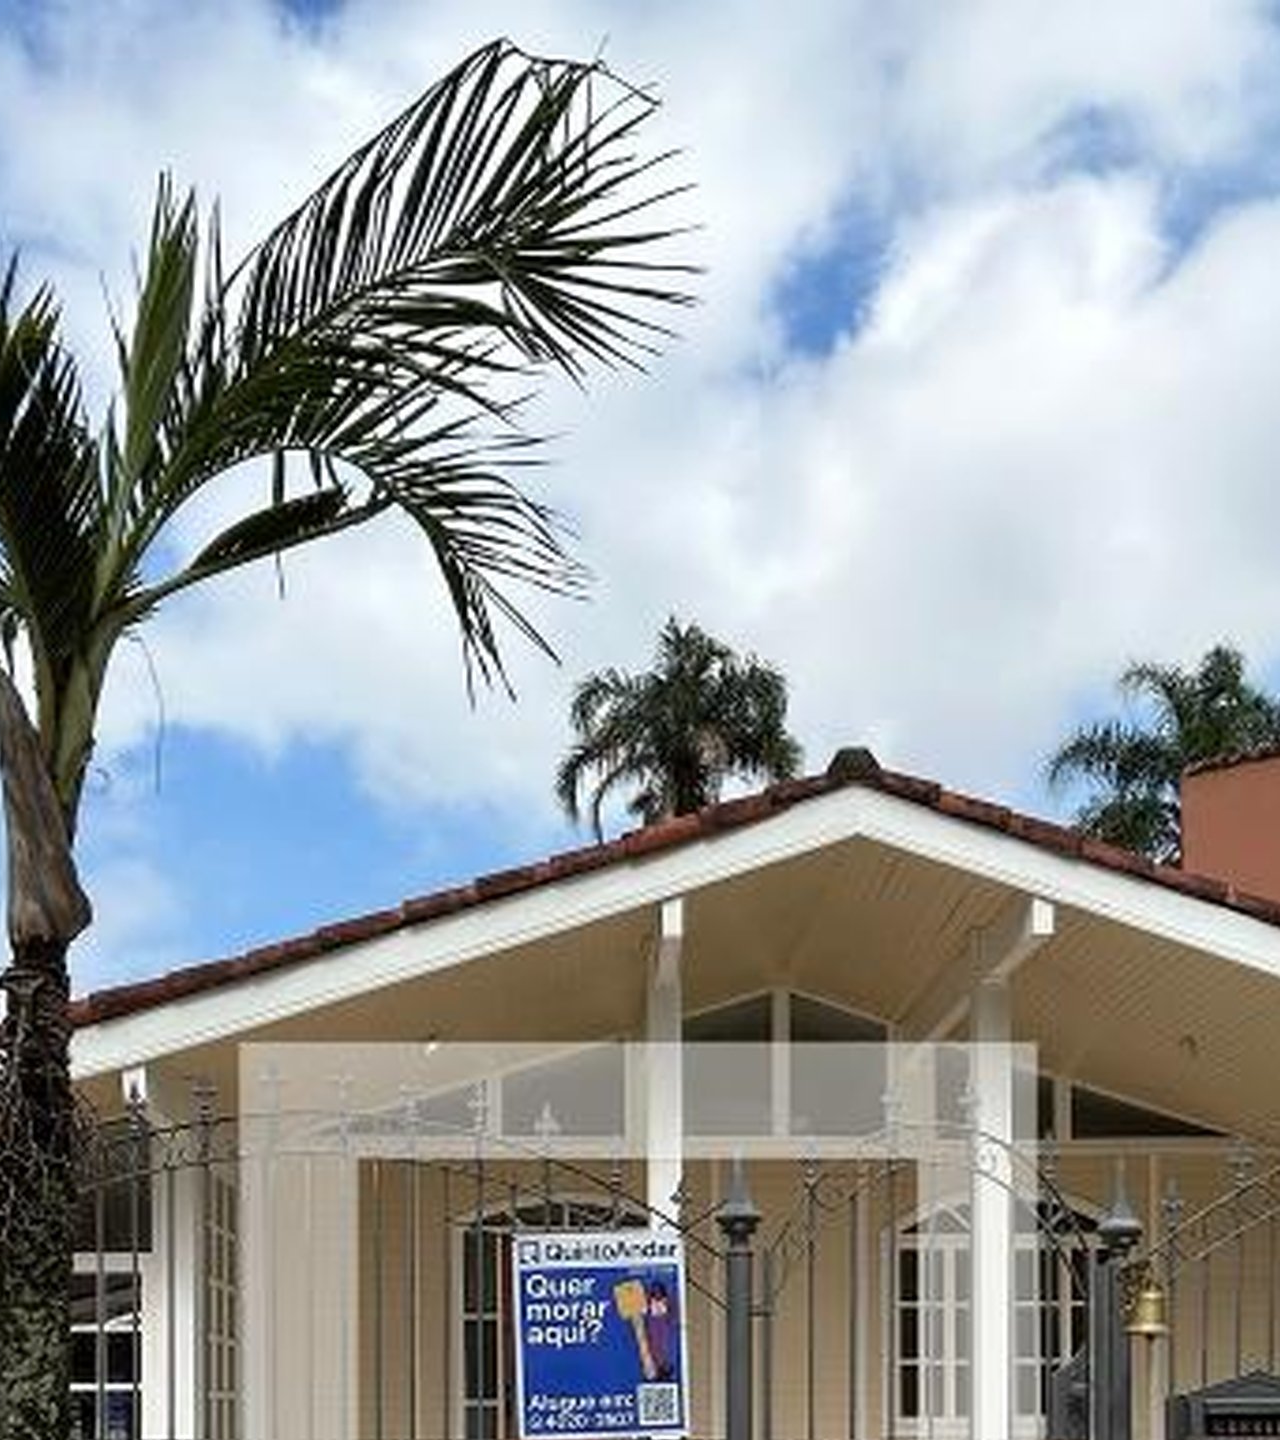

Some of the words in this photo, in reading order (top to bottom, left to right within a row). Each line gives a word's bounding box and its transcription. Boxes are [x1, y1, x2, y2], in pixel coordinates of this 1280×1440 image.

[526, 1275, 596, 1298] Quer
[526, 1301, 609, 1320] morar
[527, 1320, 603, 1348] aqui?
